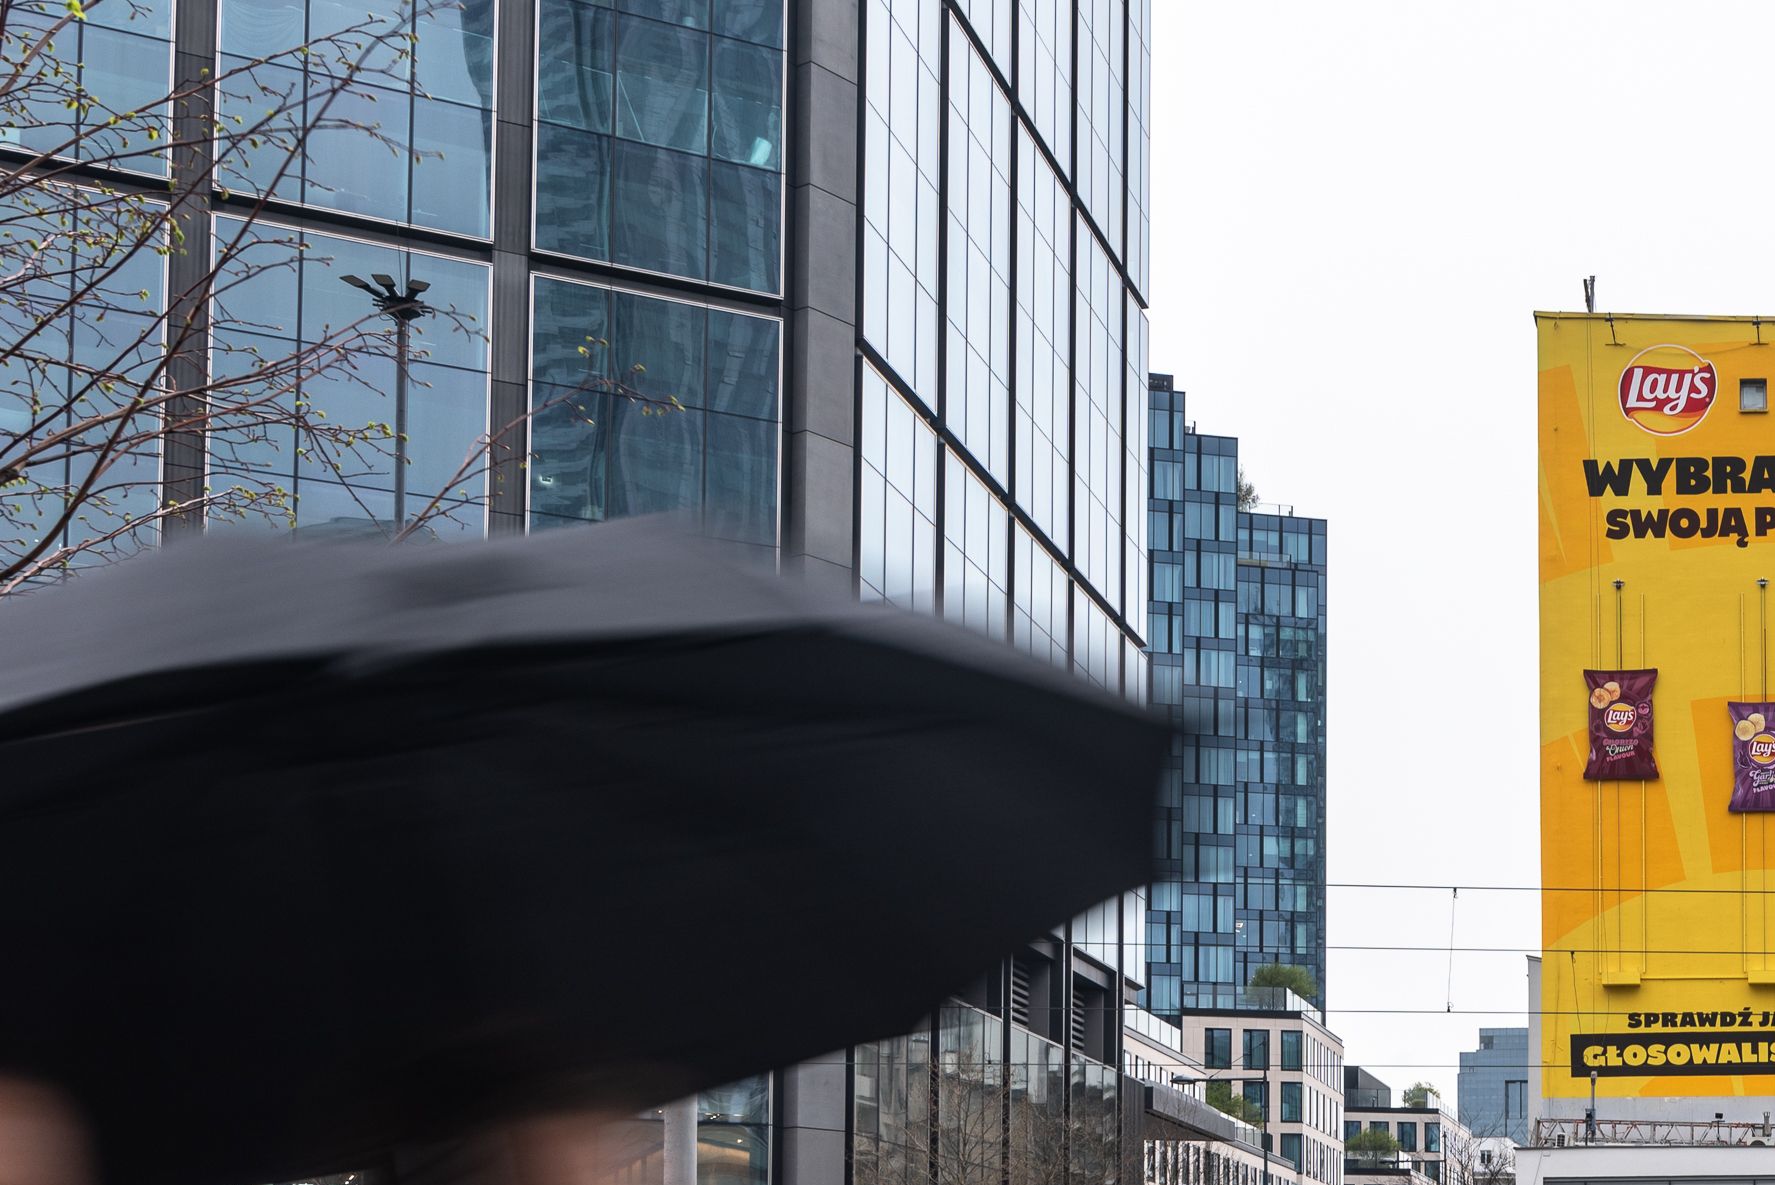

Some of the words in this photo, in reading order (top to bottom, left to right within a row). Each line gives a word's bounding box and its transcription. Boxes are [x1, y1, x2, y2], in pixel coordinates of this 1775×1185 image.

[1625, 365, 1711, 416] Lay's
[1605, 506, 1749, 548] SWOJĄ
[1607, 709, 1634, 726] Lay's
[1627, 1006, 1754, 1029] SPRAWDŹ
